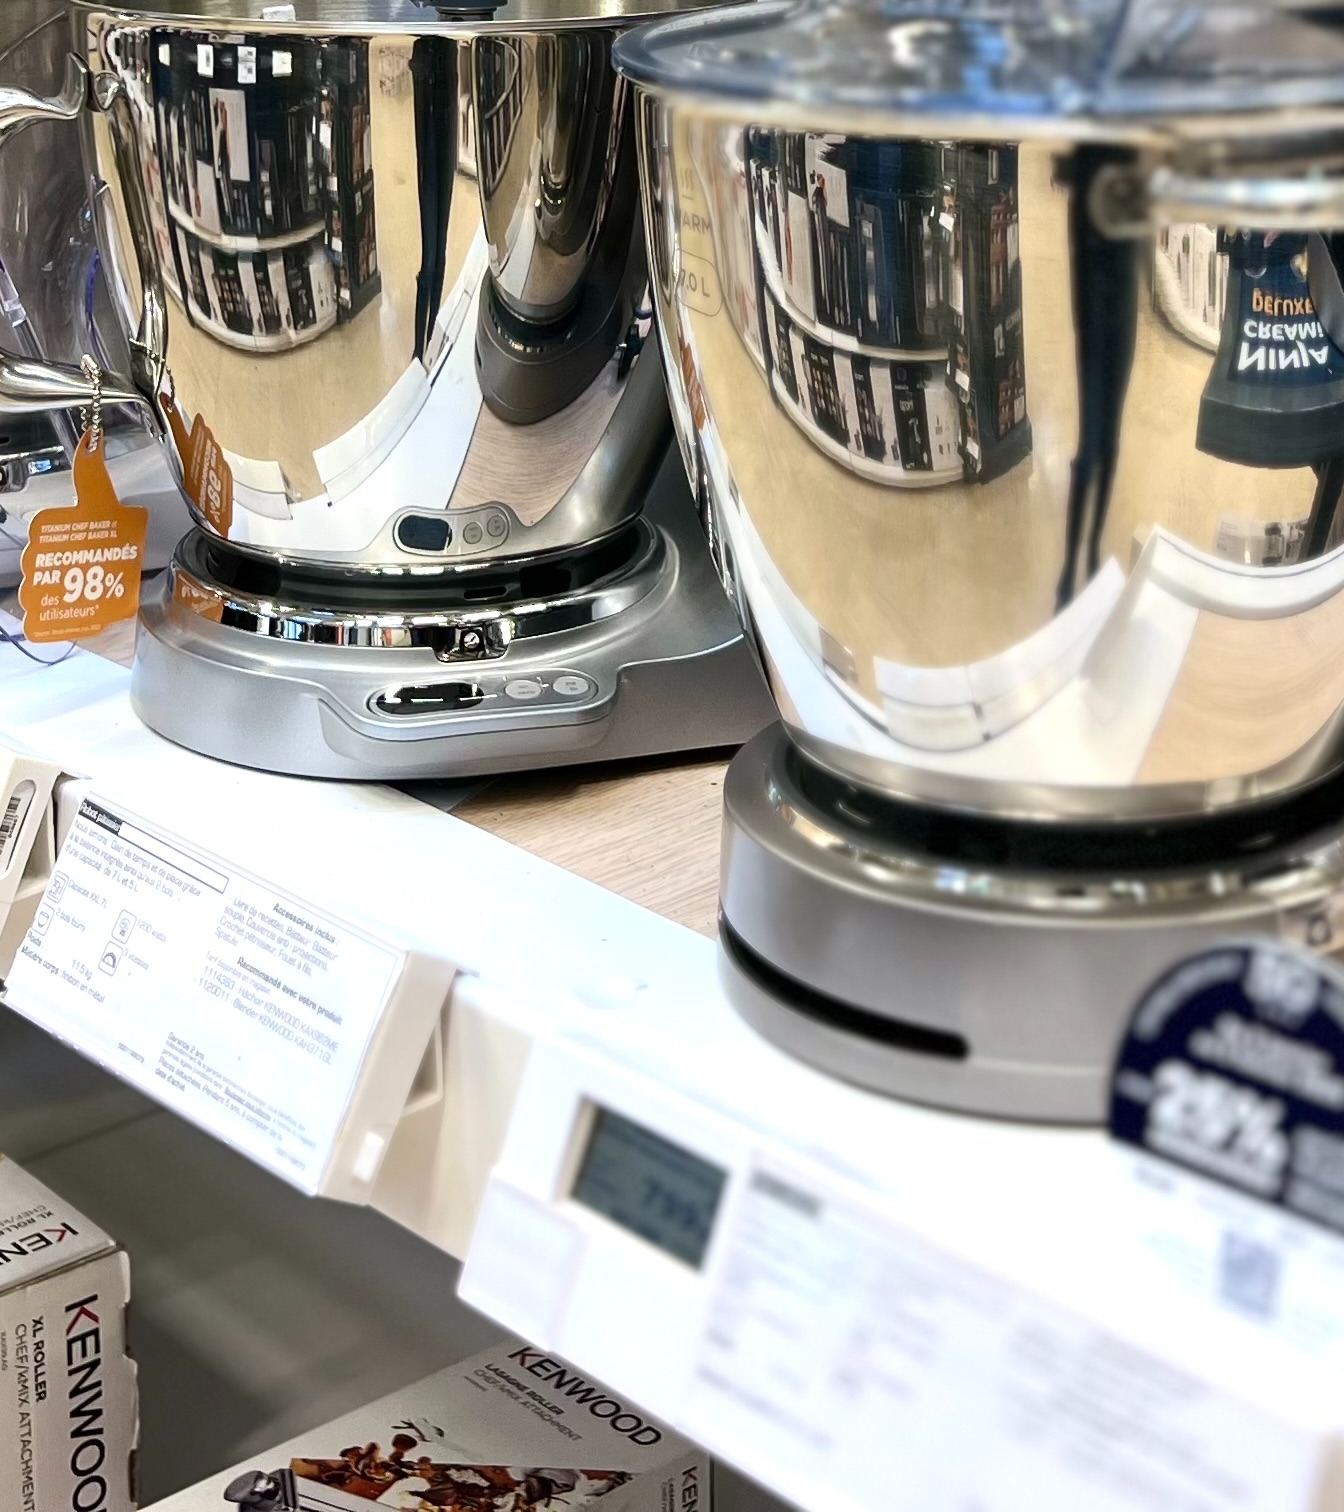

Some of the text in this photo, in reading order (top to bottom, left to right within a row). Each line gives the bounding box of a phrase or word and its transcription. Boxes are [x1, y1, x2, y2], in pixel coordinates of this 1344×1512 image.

[677, 211, 712, 235] ARM
[88, 530, 109, 540] BAKER
[89, 520, 111, 529] BAKER
[35, 543, 138, 568] RECOMMANDÉS
[33, 565, 124, 603] PAR 98%
[40, 594, 60, 607] des
[41, 1210, 54, 1221] XL
[31, 1316, 47, 1403] XL ROLLER
[64, 1293, 109, 1512] KENWOO
[507, 1346, 662, 1446] KENWOOD
[18, 1411, 36, 1512] ATTACHMENT
